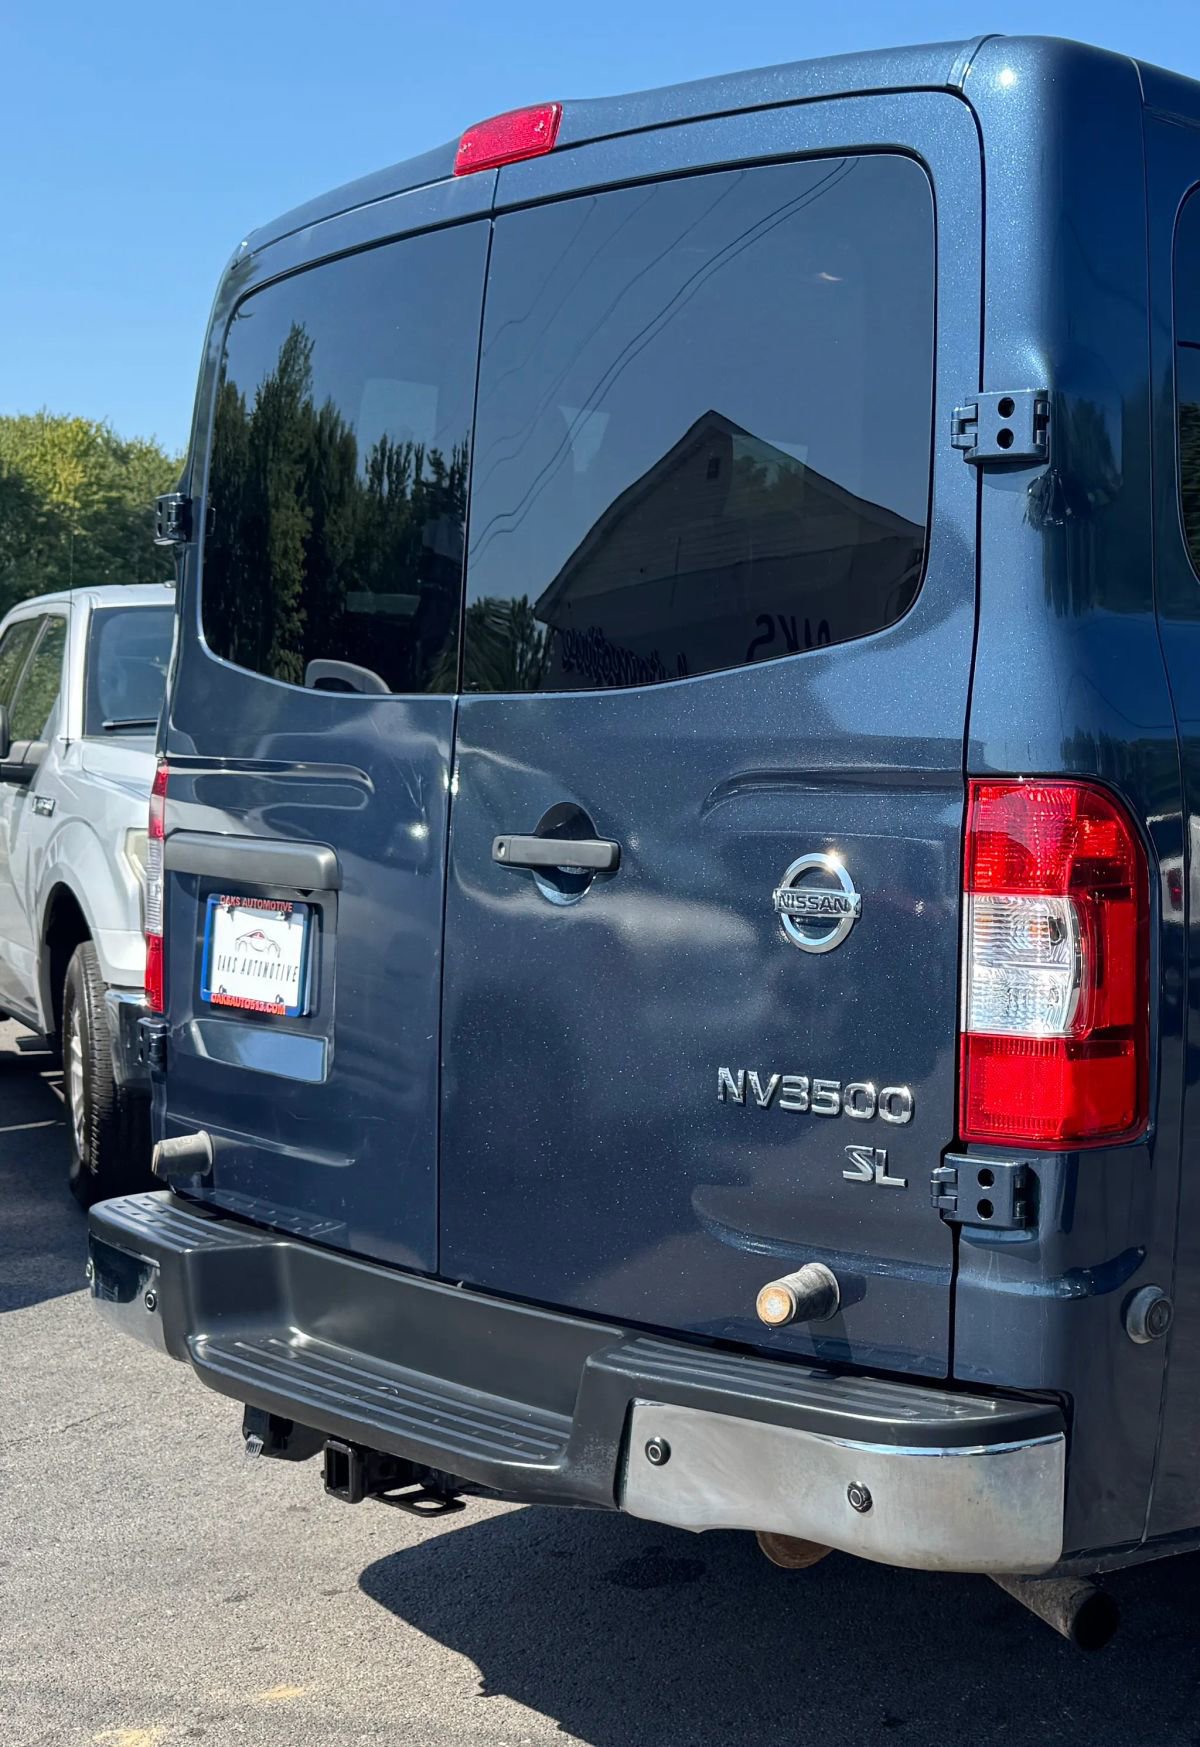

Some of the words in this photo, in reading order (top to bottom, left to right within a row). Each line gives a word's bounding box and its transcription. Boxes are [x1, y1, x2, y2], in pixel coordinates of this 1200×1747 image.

[220, 895, 241, 906] OAKS
[242, 899, 293, 912] AUTOMOTIVE
[777, 894, 849, 913] NISSAN
[240, 957, 299, 982] AUTOMOTIVE
[717, 1066, 915, 1125] NV3500
[842, 1144, 908, 1187] SL
